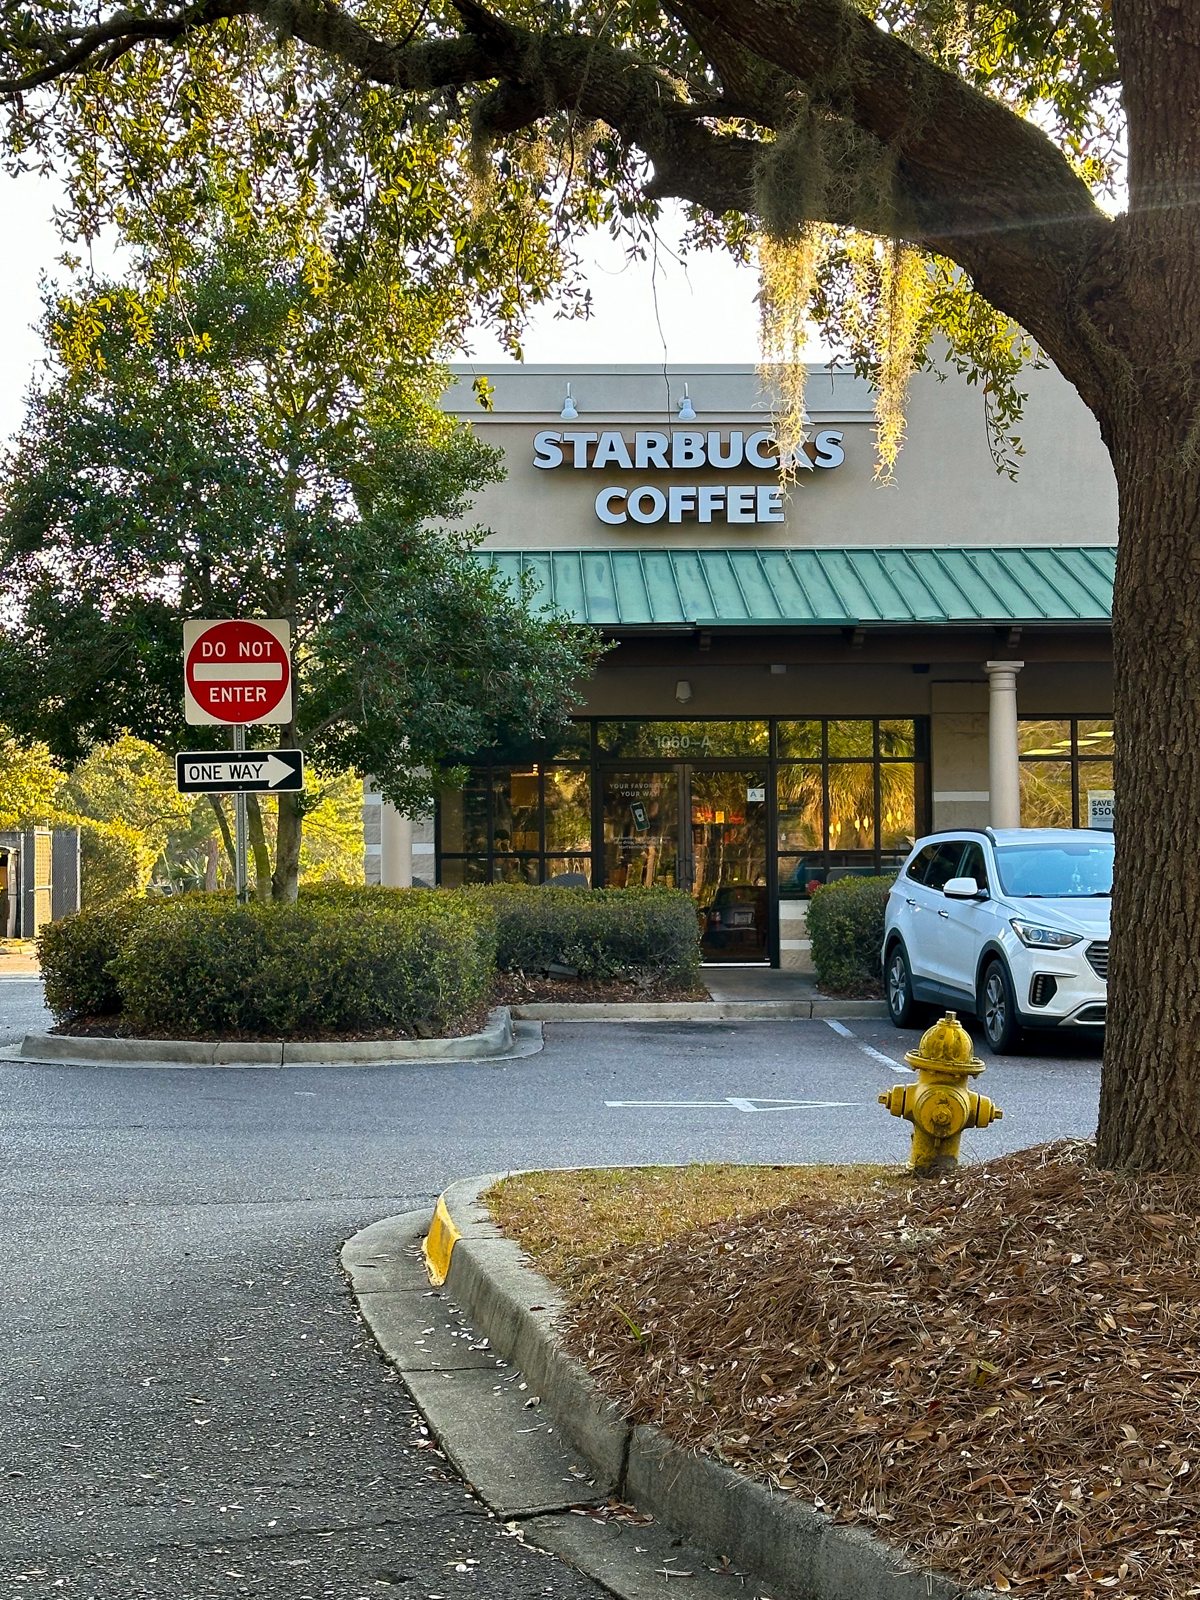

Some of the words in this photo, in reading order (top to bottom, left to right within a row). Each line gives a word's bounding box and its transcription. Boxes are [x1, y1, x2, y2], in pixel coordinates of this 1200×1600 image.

[532, 430, 846, 470] STARBUCKS
[594, 486, 786, 525] COFFEE
[202, 641, 226, 657] DO
[238, 641, 274, 657] NOT
[209, 687, 267, 703] ENTER
[189, 765, 223, 780] ONE
[229, 764, 263, 779] WAY
